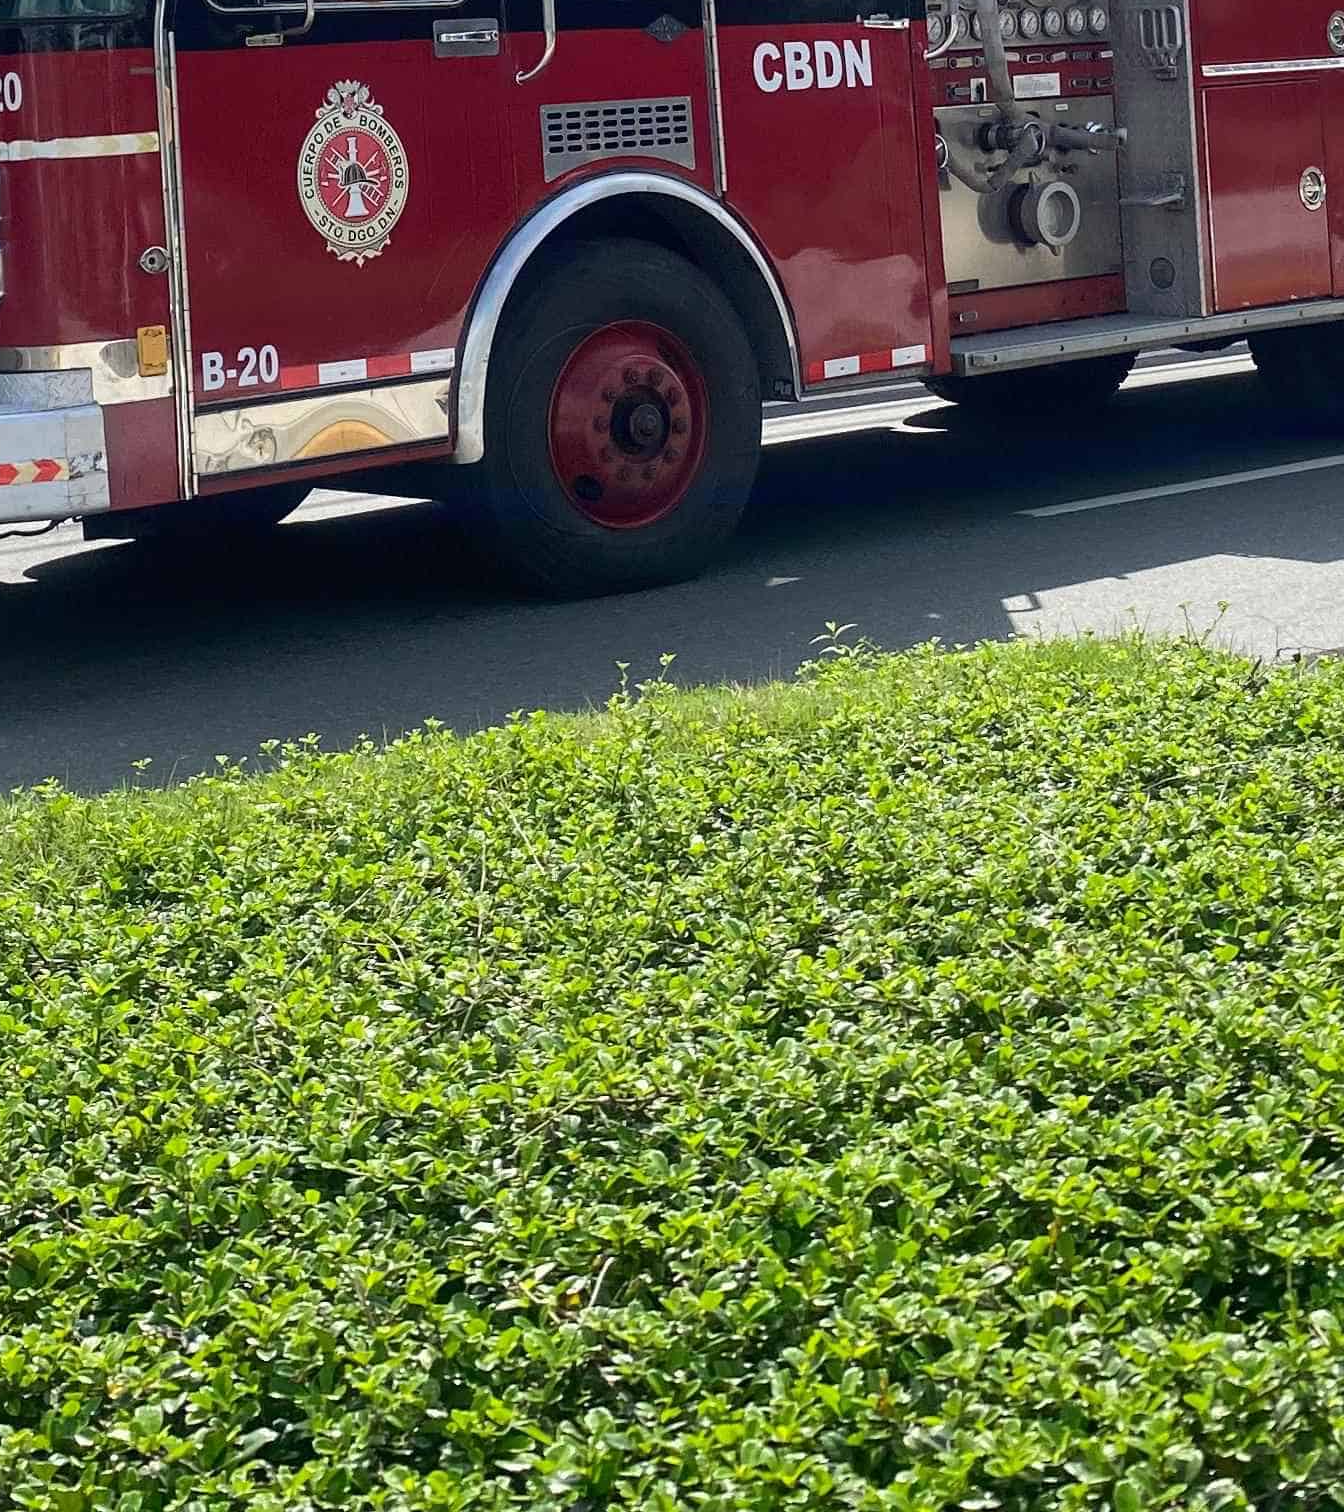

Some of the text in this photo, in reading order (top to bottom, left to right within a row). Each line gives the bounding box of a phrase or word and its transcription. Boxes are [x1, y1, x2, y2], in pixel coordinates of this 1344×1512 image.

[753, 39, 874, 93] CBDN
[303, 115, 404, 199] CUERPO DE BOMBEROS
[201, 344, 279, 392] B-20
